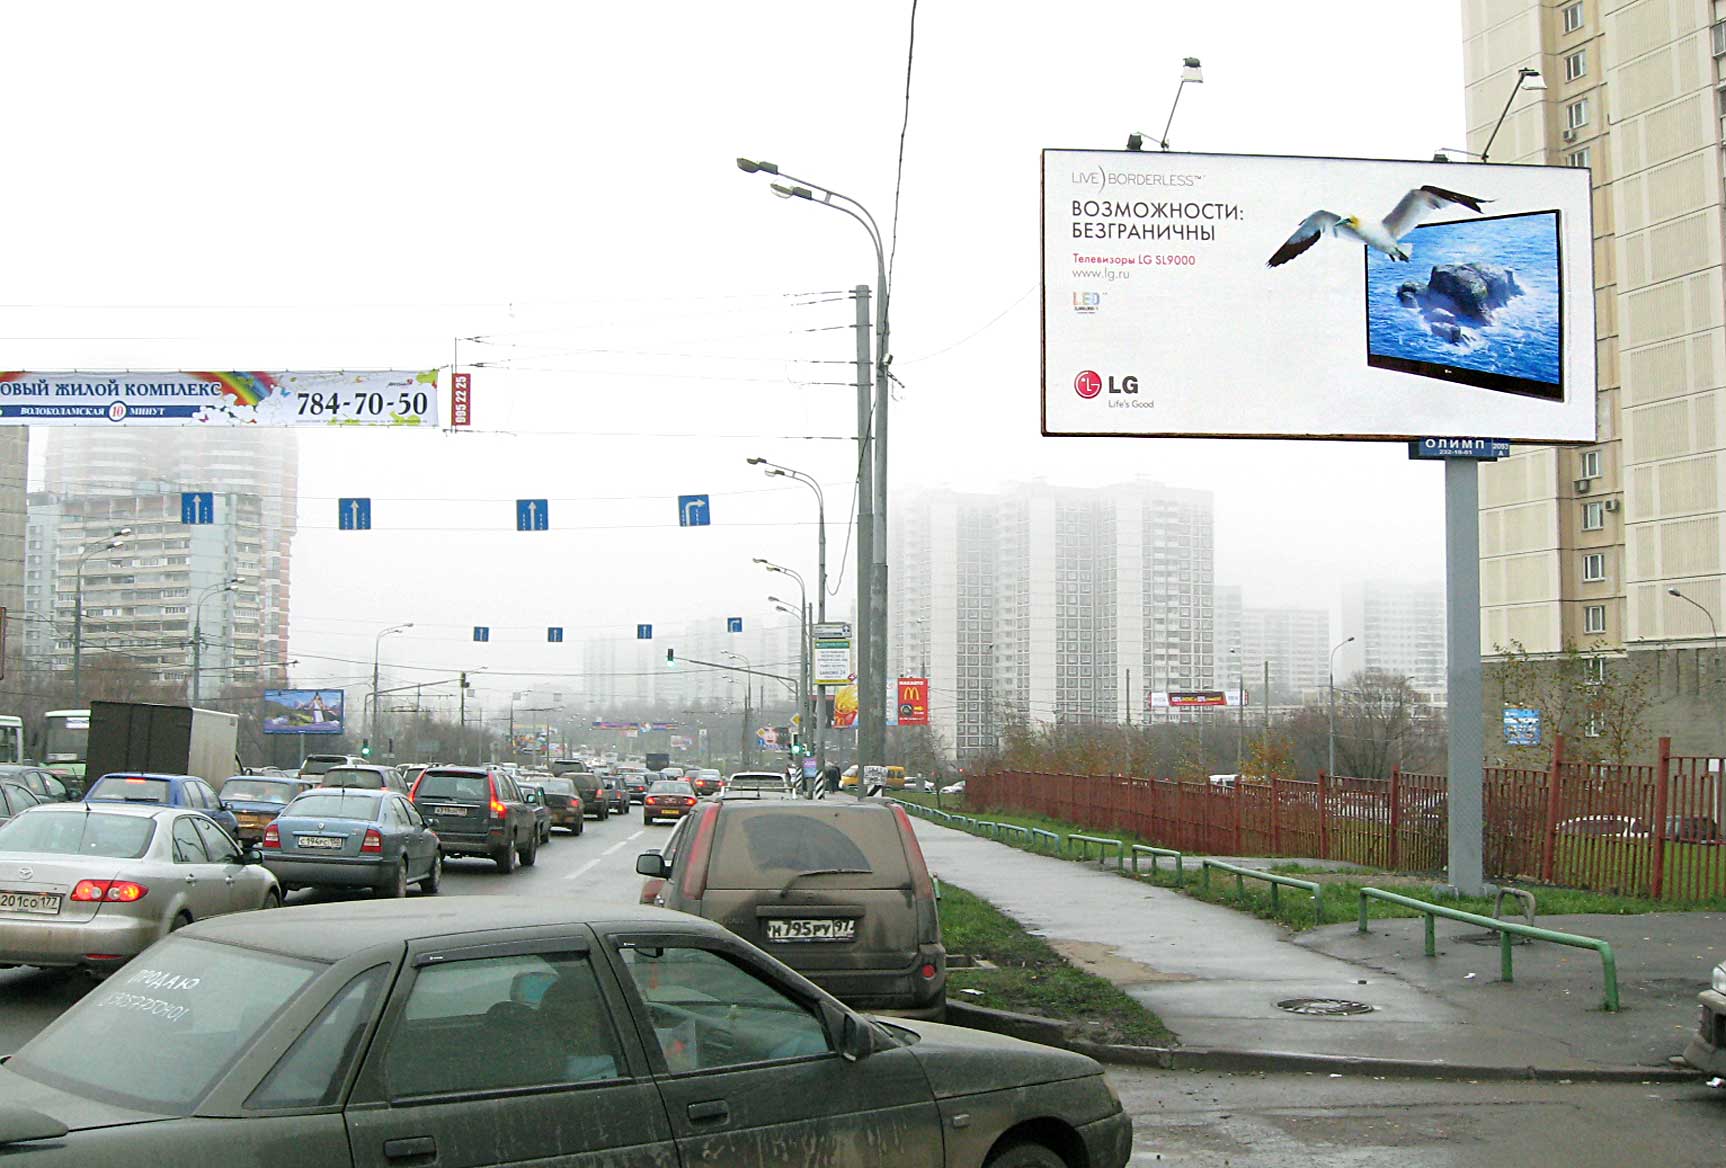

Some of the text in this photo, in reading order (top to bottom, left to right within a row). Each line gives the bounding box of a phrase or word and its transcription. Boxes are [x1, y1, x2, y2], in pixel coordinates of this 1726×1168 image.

[1072, 200, 1244, 221] ВОЗМОЖНОСТИ:
[1072, 222, 1216, 241] БЕЗГРАНИЧНЫ
[1073, 253, 1196, 266] Телевизоры LG SL9000
[1072, 268, 1130, 281] www.lg.ru
[0, 379, 222, 397] ОВЫЙ ЖИЛОЙ КОМПЛЕКС
[1108, 376, 1139, 394] LG
[20, 405, 166, 418] ВОЛОКОЛАМСКАЯ 10 МИНУТ
[297, 392, 428, 415] 784-70-50
[1108, 399, 1155, 409] Life's Good
[1425, 438, 1485, 449] ОЛИМП
[127, 969, 200, 990] ПРОДАЮ
